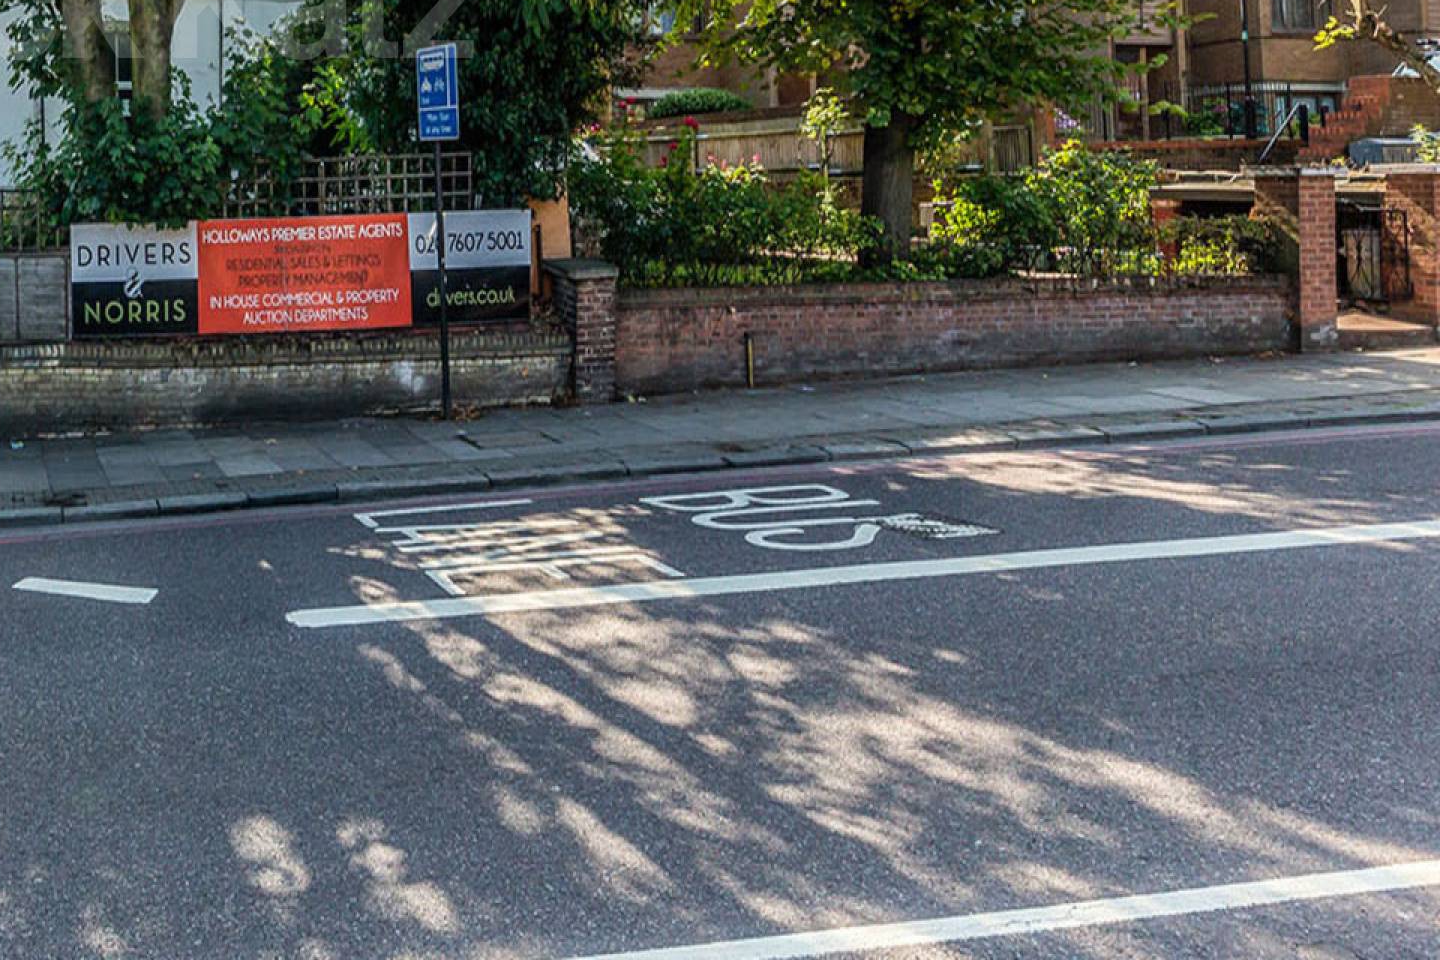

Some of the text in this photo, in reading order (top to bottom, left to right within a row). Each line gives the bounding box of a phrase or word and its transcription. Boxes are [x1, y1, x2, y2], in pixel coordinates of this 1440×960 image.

[202, 222, 403, 244] HOLLOWAYS PREMIER ESTATE AGENTS
[415, 230, 525, 254] 02 7607 5001
[77, 242, 191, 267] DRIVERS
[289, 256, 321, 270] SALES
[210, 288, 399, 309] IN HOUSE COMMERCIAL & PROPERTY
[83, 299, 187, 324] NORRIS
[243, 306, 369, 325] AUCTION DEPARTMENTS
